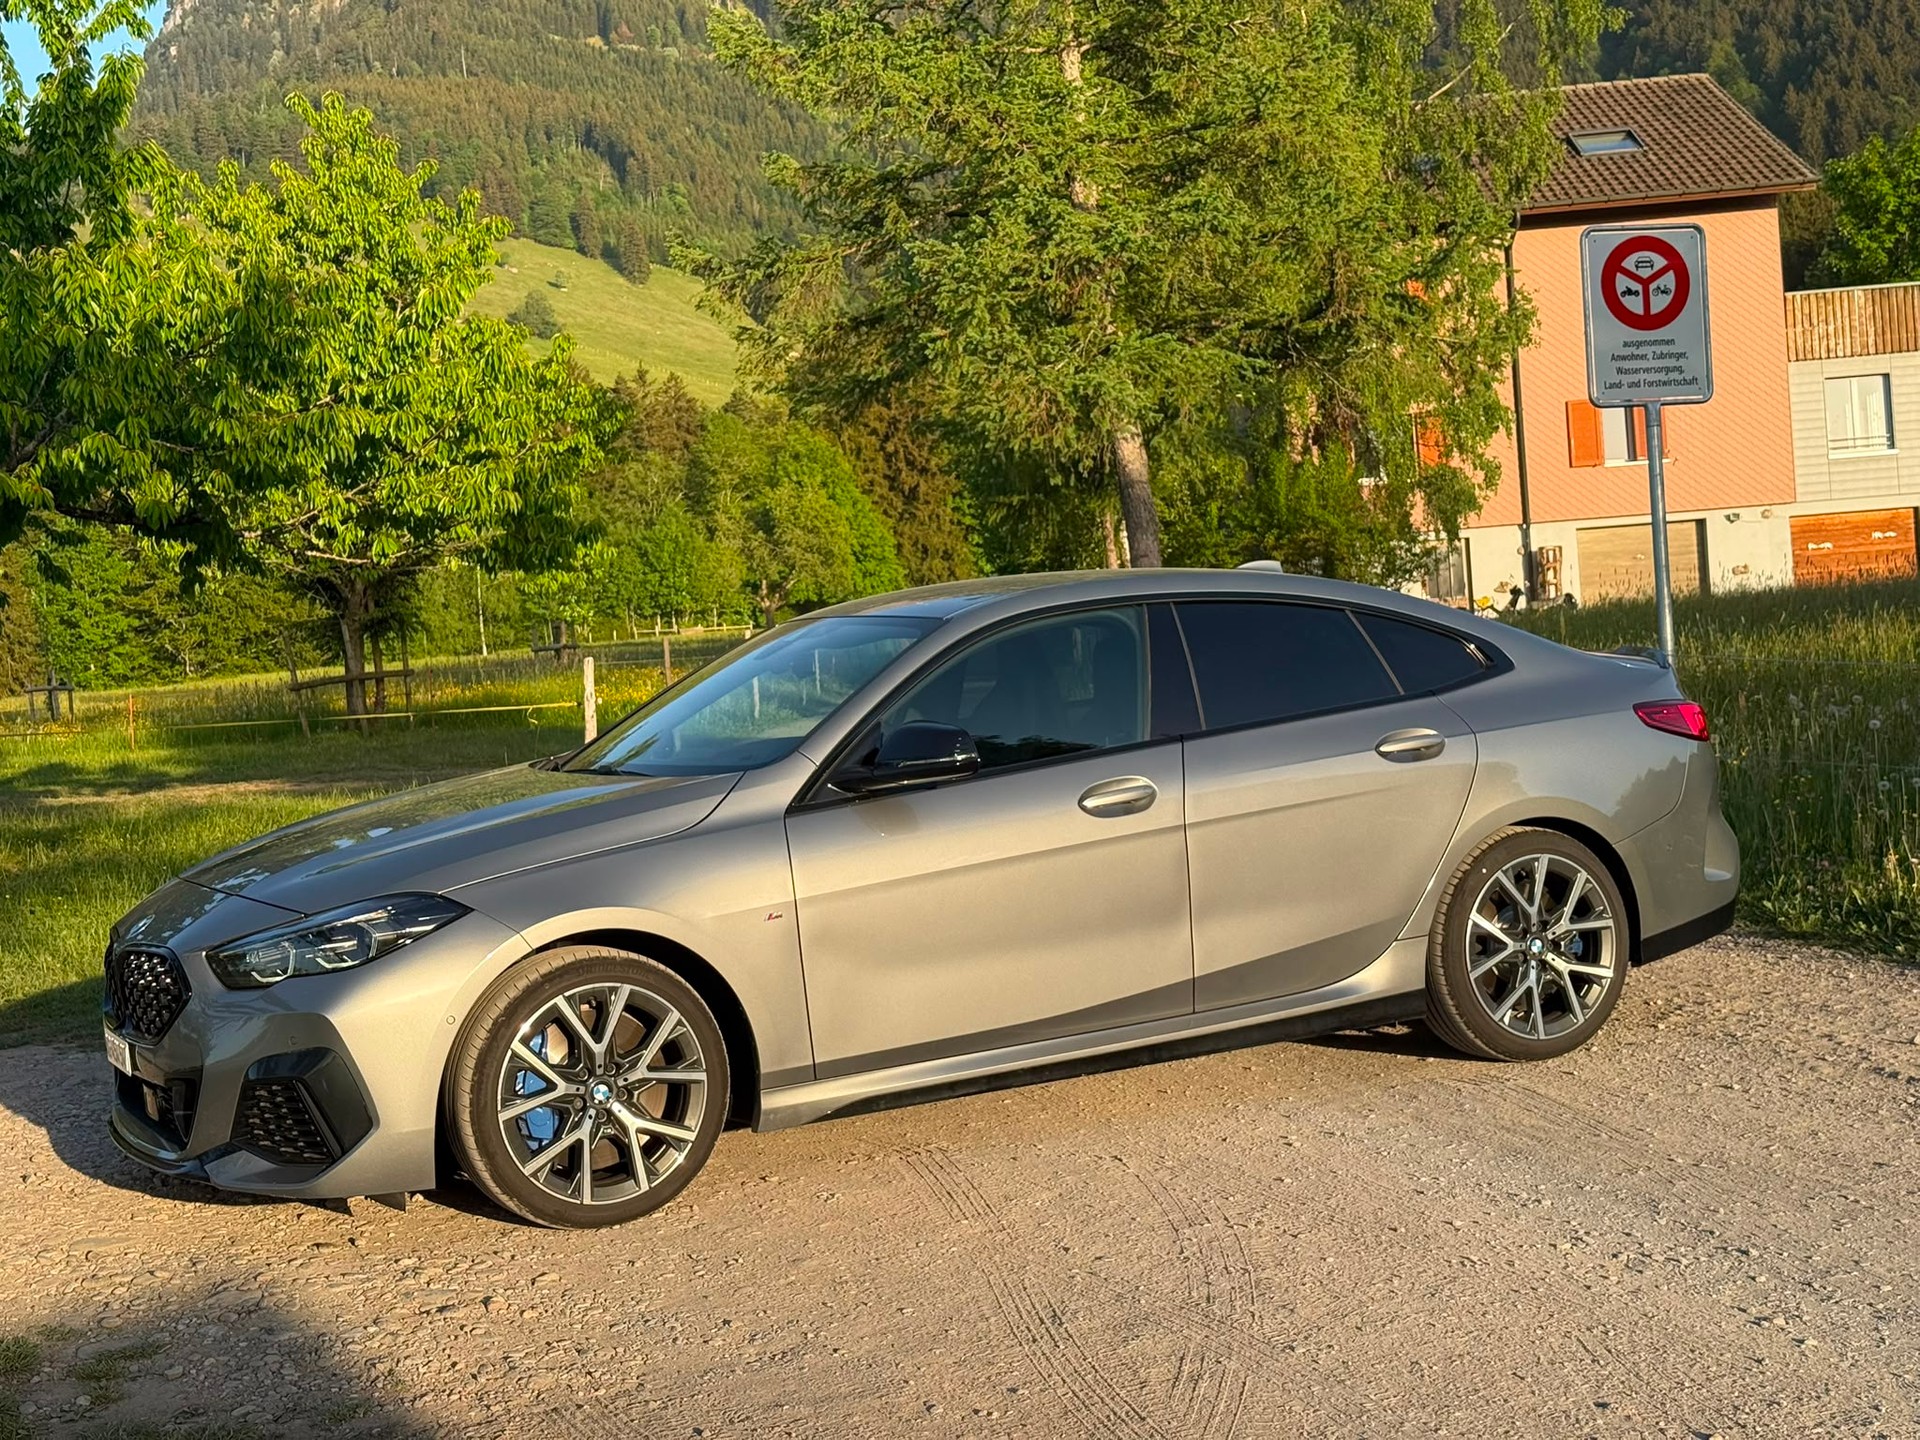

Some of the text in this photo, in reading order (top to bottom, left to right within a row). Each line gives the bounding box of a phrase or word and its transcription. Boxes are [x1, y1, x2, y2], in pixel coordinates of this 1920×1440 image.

[1622, 338, 1675, 350] ausgenommen
[1610, 350, 1689, 362] Anwohner, Zubringer,
[1615, 364, 1685, 376] Wasserversorgung,
[1603, 376, 1699, 390] Land- und Forstwirtschaft
